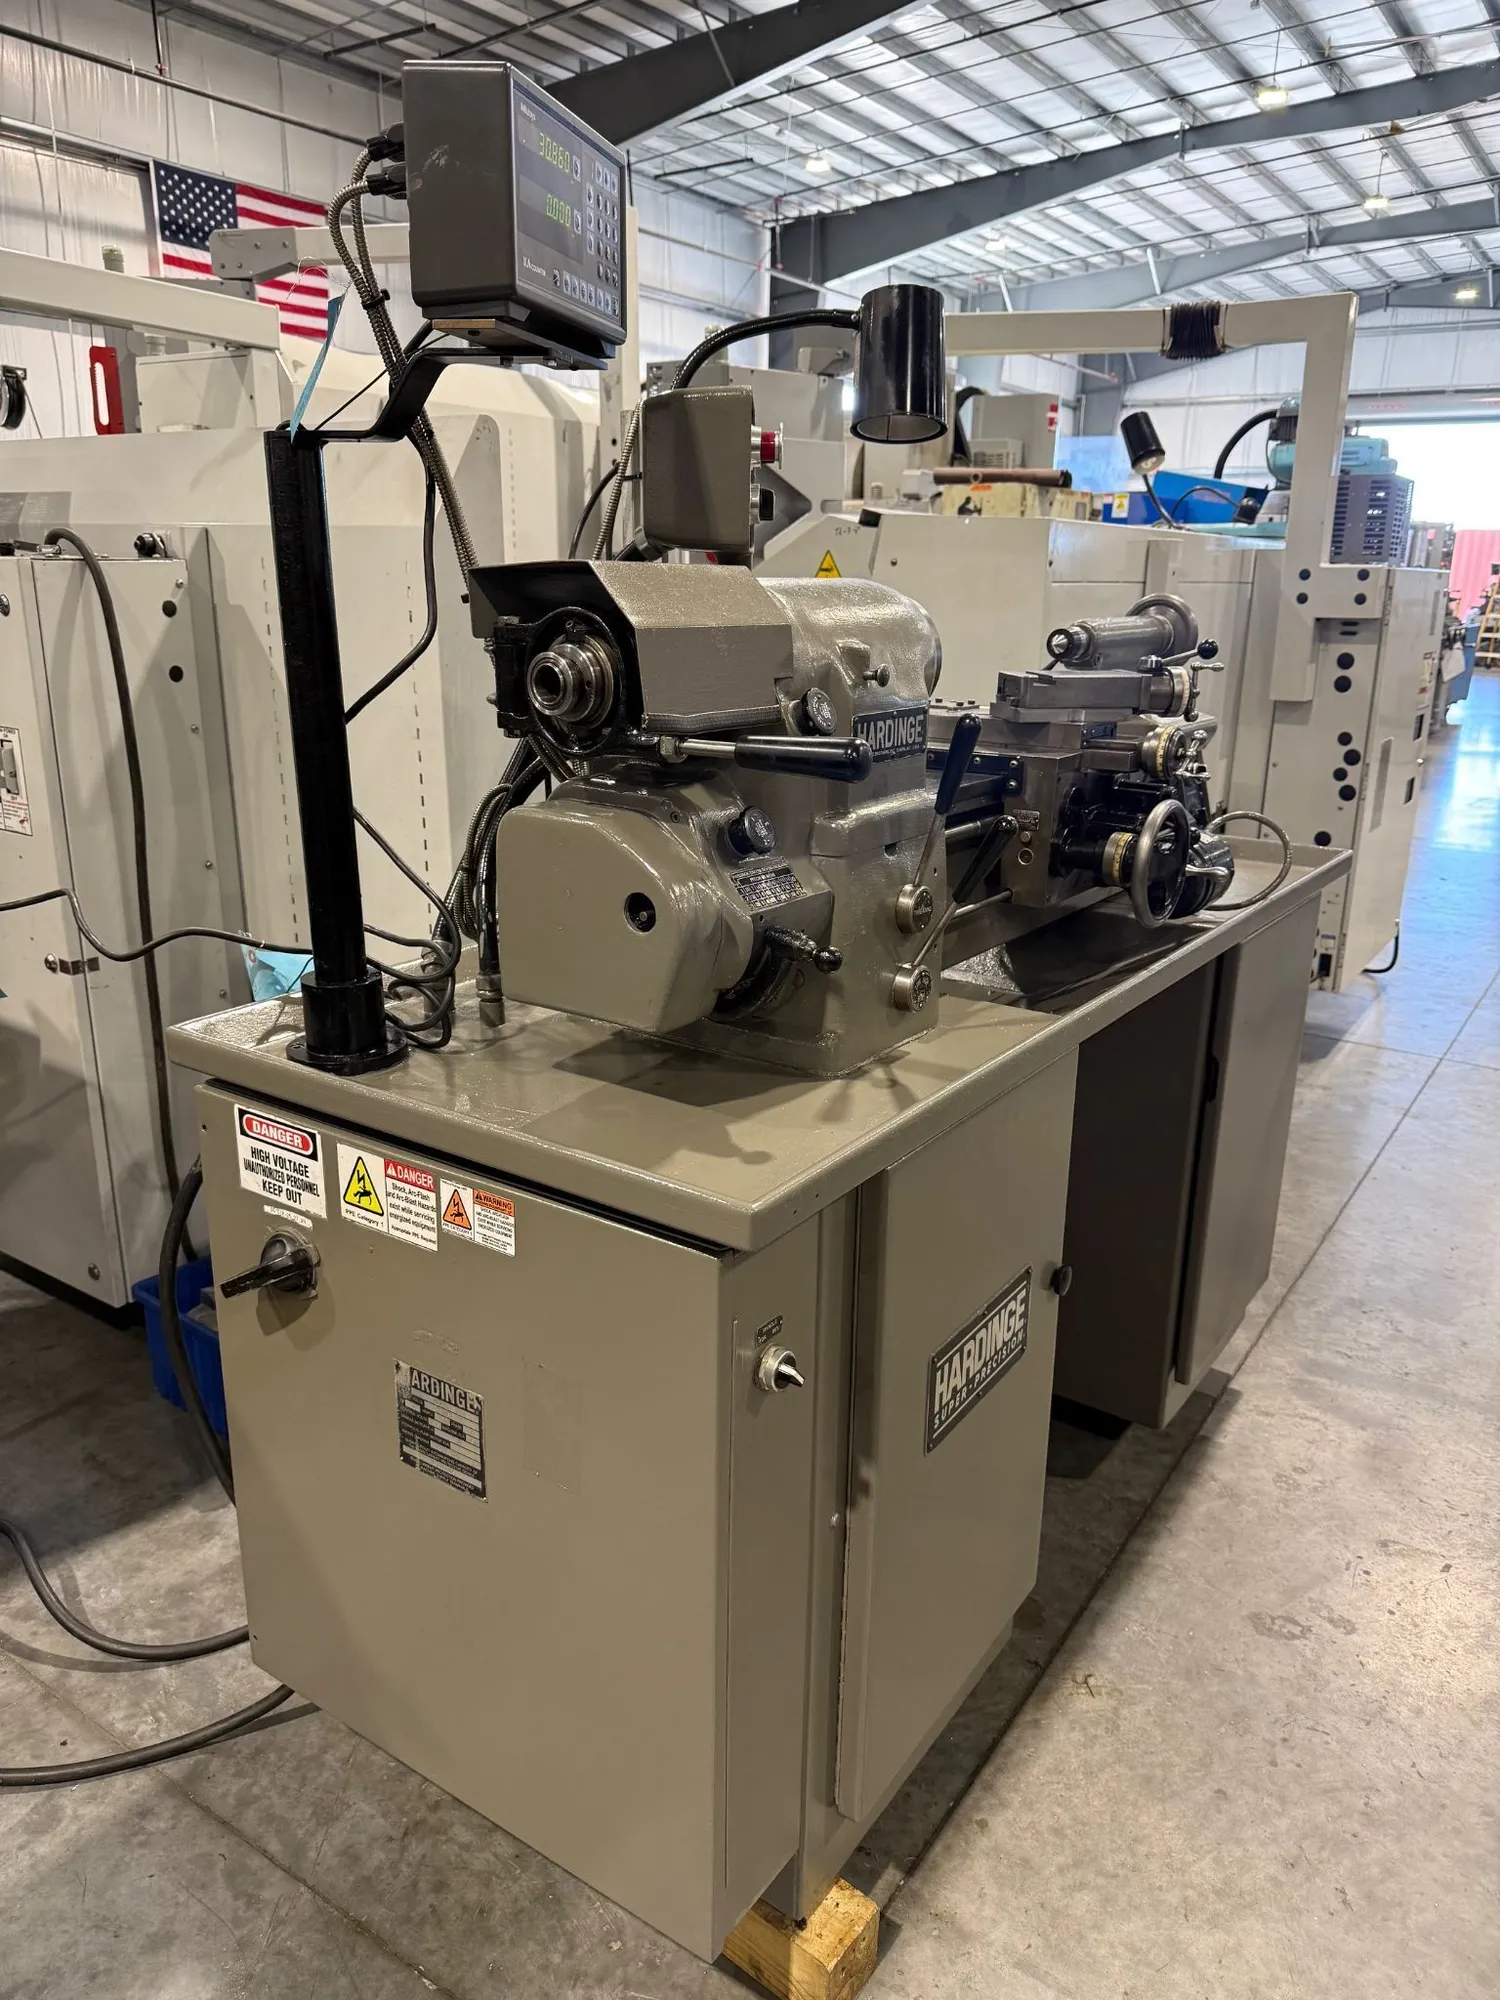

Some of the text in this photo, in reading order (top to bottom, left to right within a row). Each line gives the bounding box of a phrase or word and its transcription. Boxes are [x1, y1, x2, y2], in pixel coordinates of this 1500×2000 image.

[857, 714, 924, 750] HARDINGE
[252, 1119, 303, 1149] DANGER
[251, 1146, 310, 1179] HIGH VOLTAGE
[243, 1158, 320, 1197] UNAUTHORIZED PERSONNEL
[396, 1165, 434, 1189] DANGER
[262, 1179, 303, 1205] KEEP OUT
[387, 1190, 396, 1199] and
[392, 1182, 430, 1202] Shock, Arc-Flash
[482, 1193, 512, 1211] WARNING
[356, 1212, 379, 1227] Category
[389, 1202, 435, 1225] exist while servicing
[389, 1212, 436, 1233] energized equipment
[933, 1287, 1026, 1415] HARDINGE
[404, 1367, 481, 1414] ARDINGE
